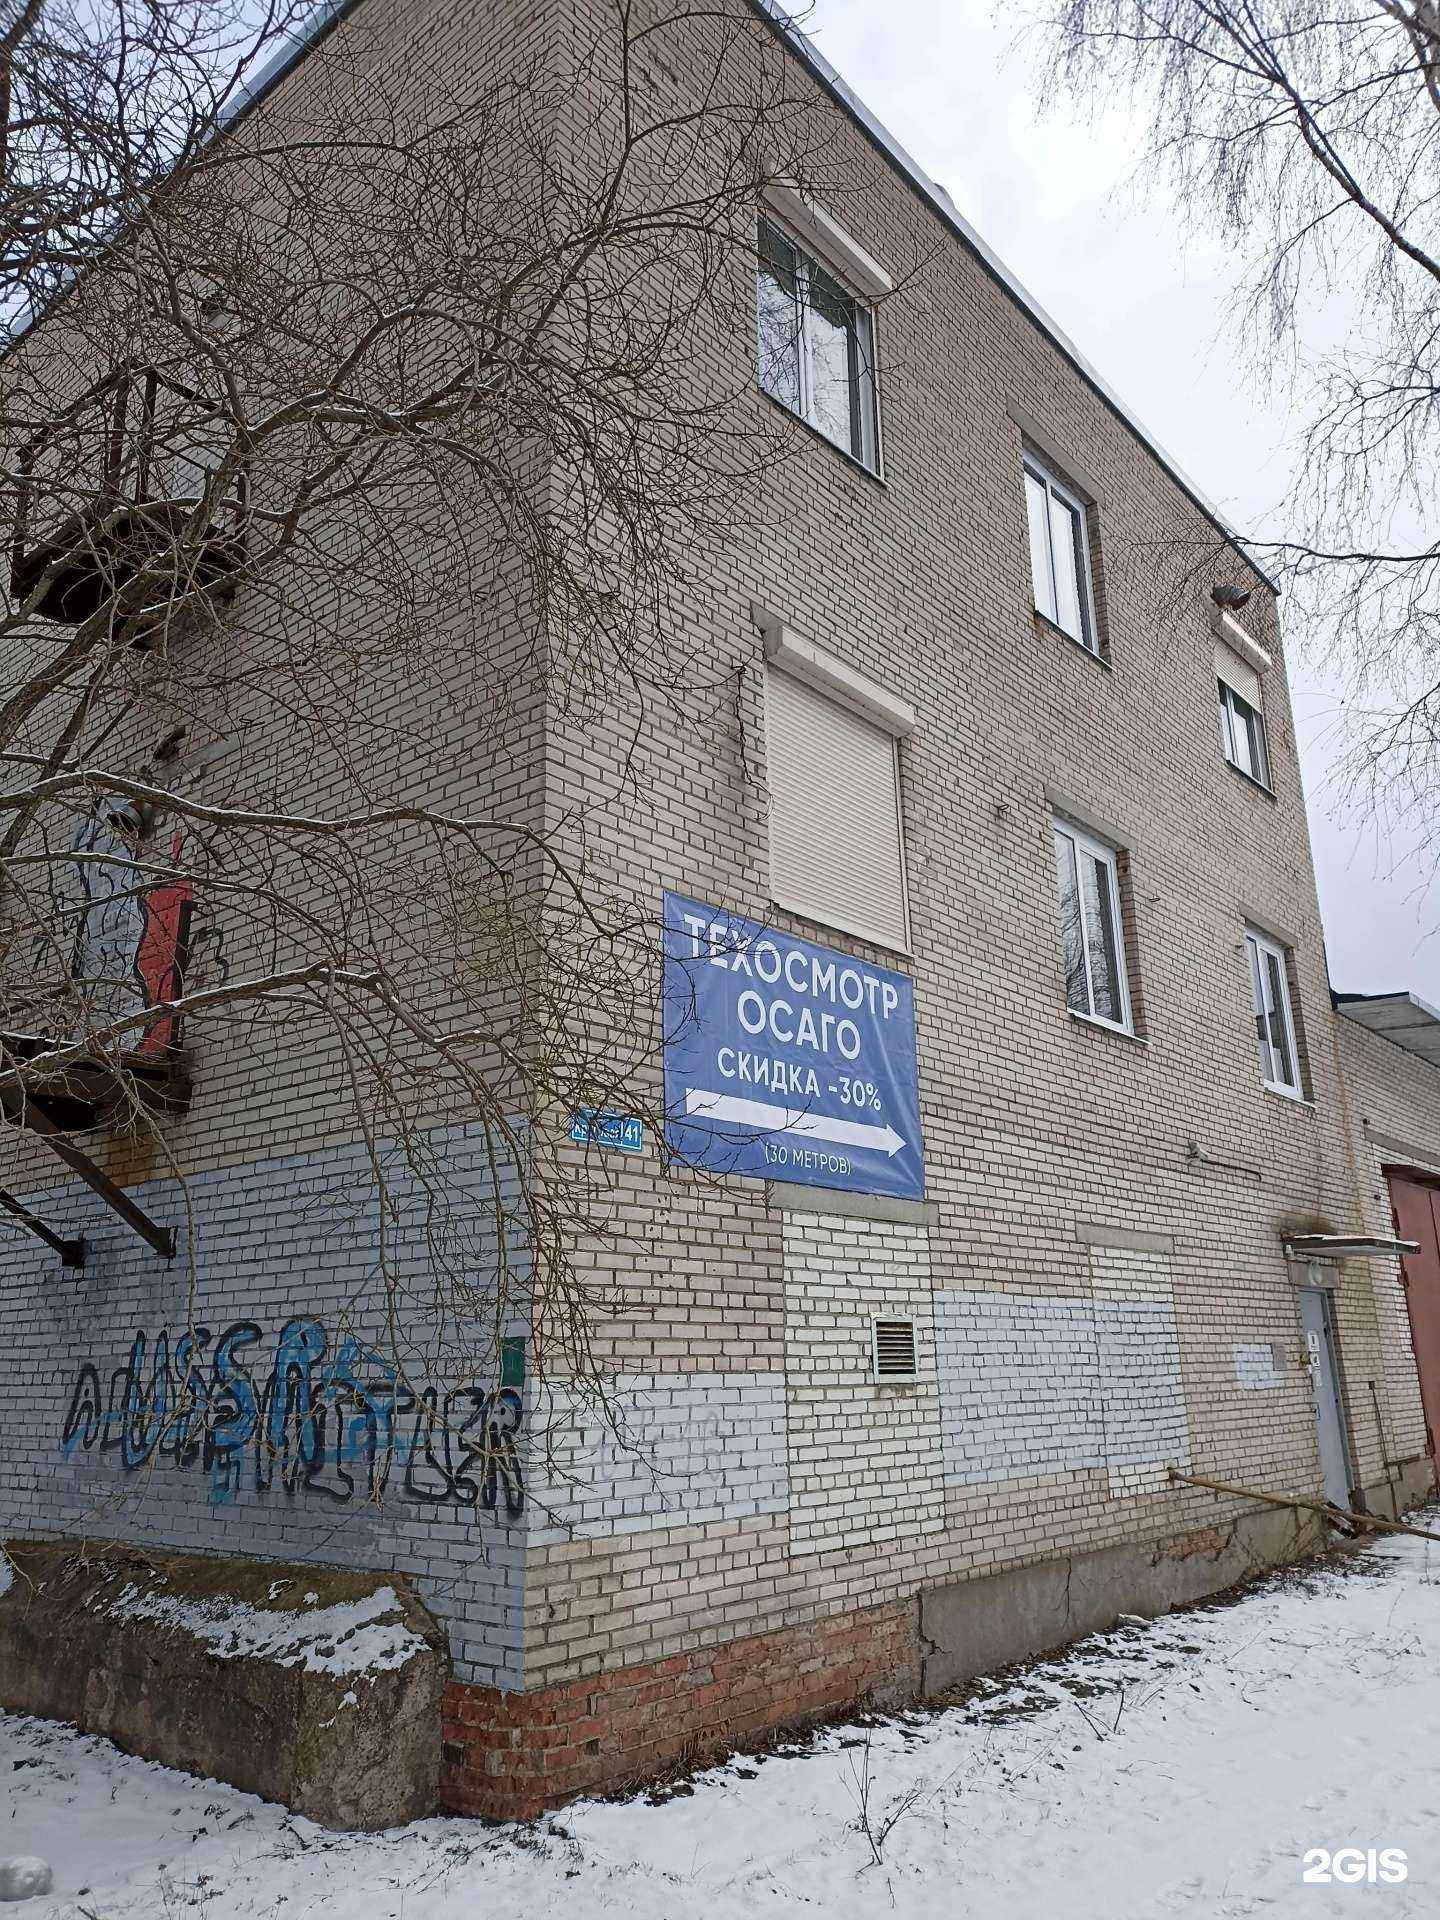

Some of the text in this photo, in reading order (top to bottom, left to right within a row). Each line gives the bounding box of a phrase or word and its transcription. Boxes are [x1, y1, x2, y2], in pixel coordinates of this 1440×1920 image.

[684, 914, 899, 1019] ТЕХОСМОТР
[737, 990, 861, 1060] ОСАГО
[717, 1047, 882, 1111] СКИДКА -30%
[624, 1124, 638, 1143] 41
[765, 1143, 851, 1176] (30 МЕТРОВ)
